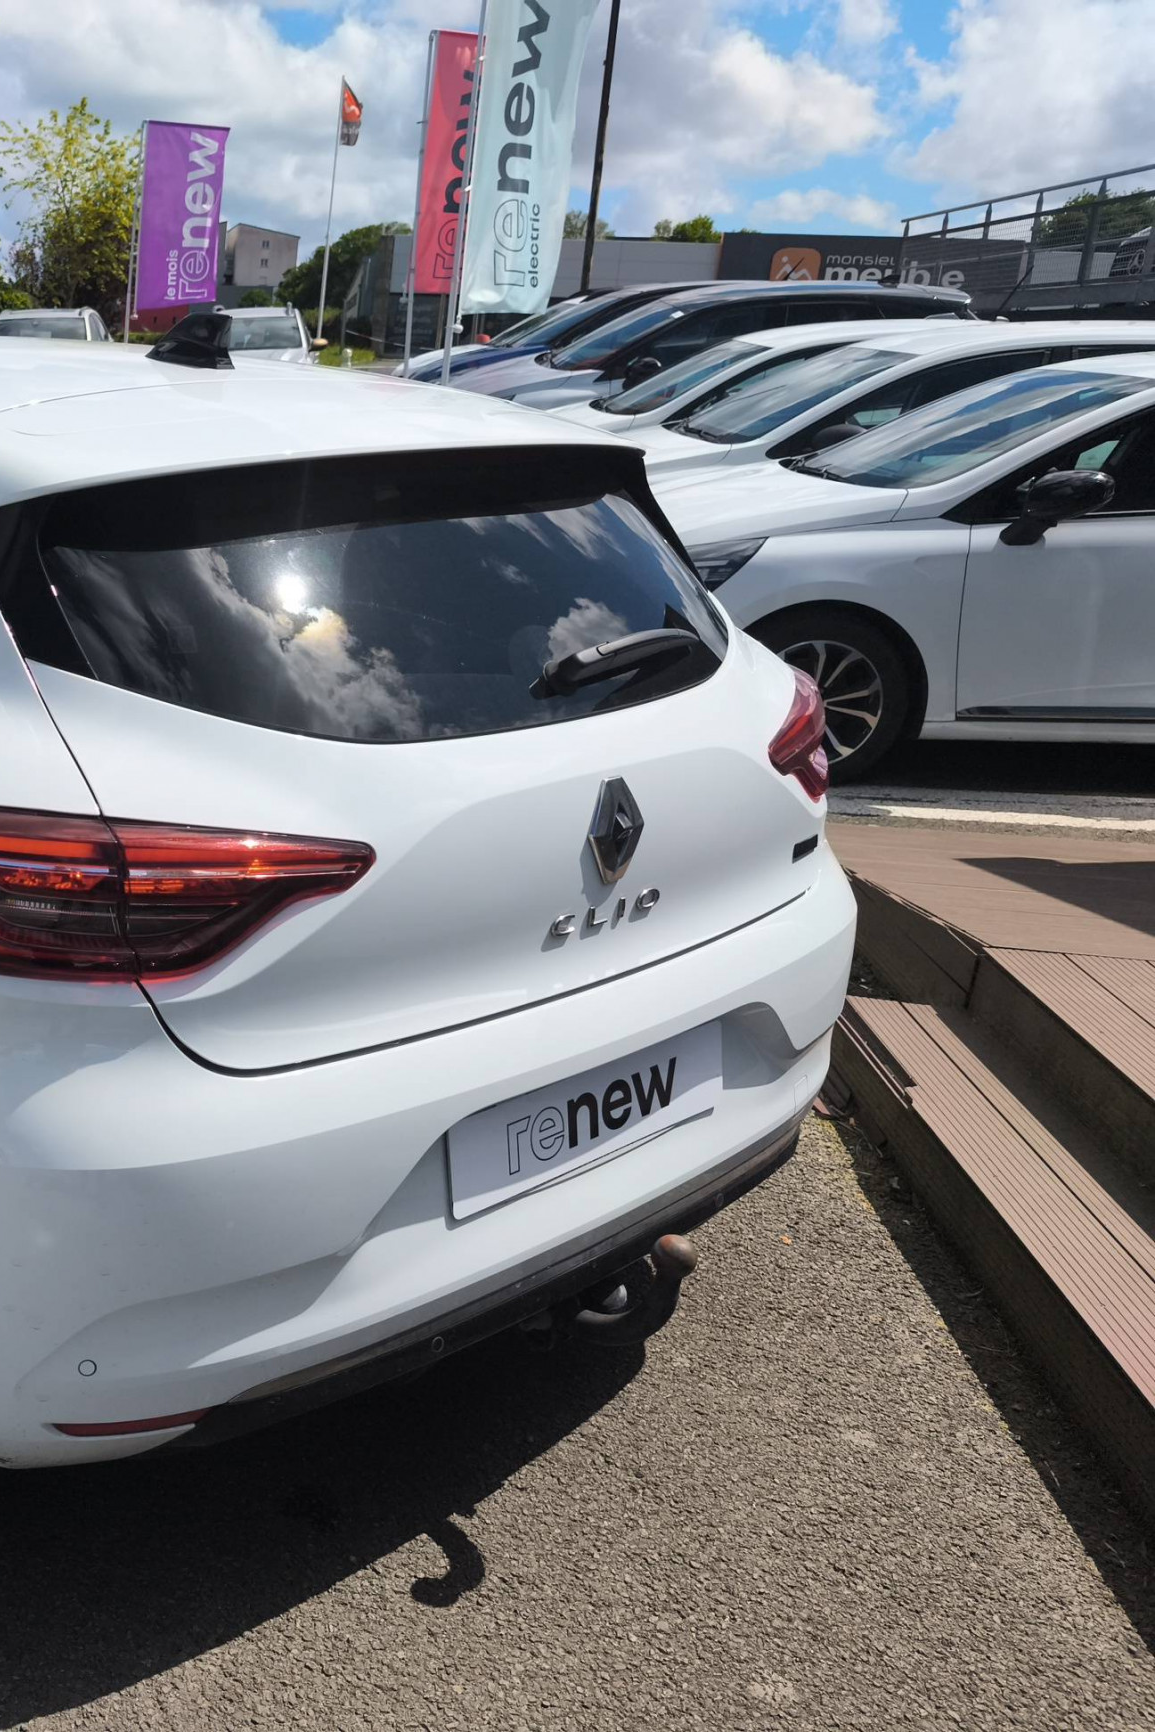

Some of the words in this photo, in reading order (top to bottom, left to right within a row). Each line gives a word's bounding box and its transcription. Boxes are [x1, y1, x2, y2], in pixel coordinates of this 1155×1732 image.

[494, 0, 550, 288] renew
[165, 249, 179, 283] mois
[179, 132, 219, 300] renew
[528, 203, 541, 288] electric
[551, 887, 660, 938] CLIO
[507, 1057, 676, 1174] renew
